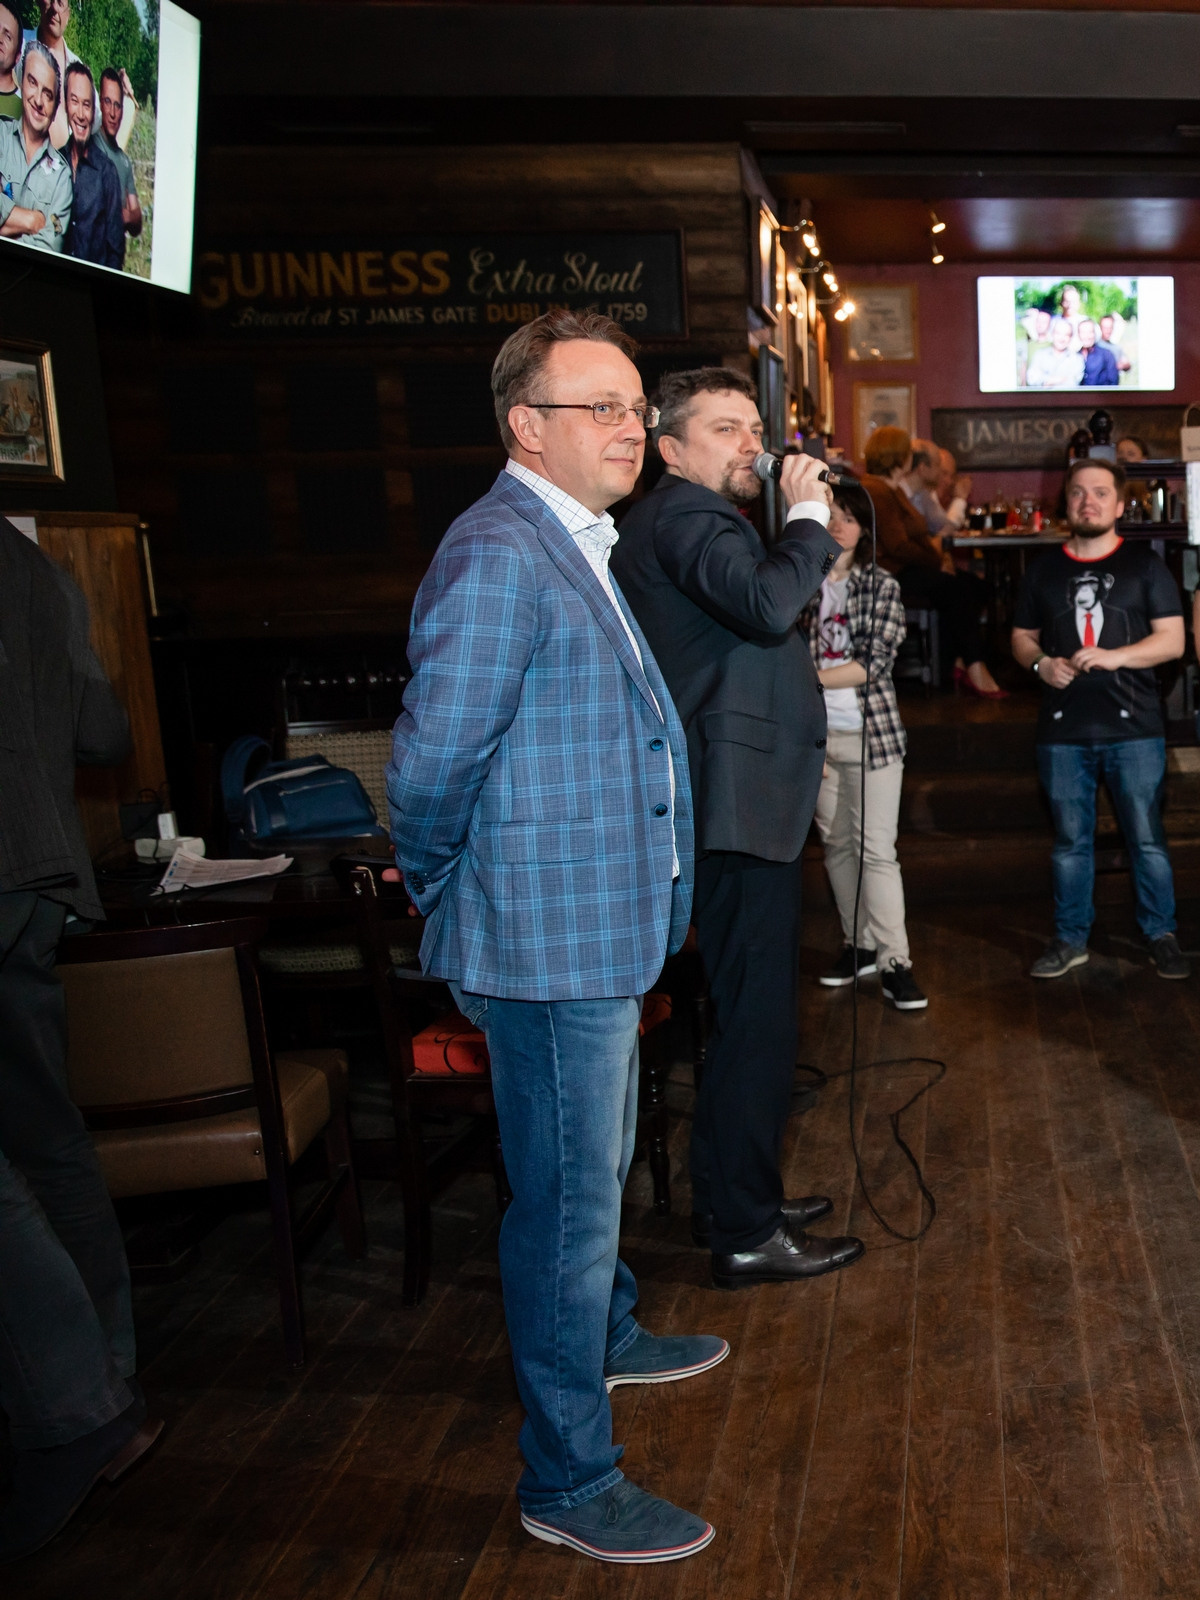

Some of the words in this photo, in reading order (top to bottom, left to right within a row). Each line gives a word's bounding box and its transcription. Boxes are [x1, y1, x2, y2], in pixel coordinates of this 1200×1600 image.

[196, 249, 452, 311] GUINNESS
[465, 245, 558, 301] Extra
[562, 250, 645, 295] Stout
[337, 308, 360, 326] ST
[364, 306, 426, 326] JAMES
[430, 305, 477, 325] GATE
